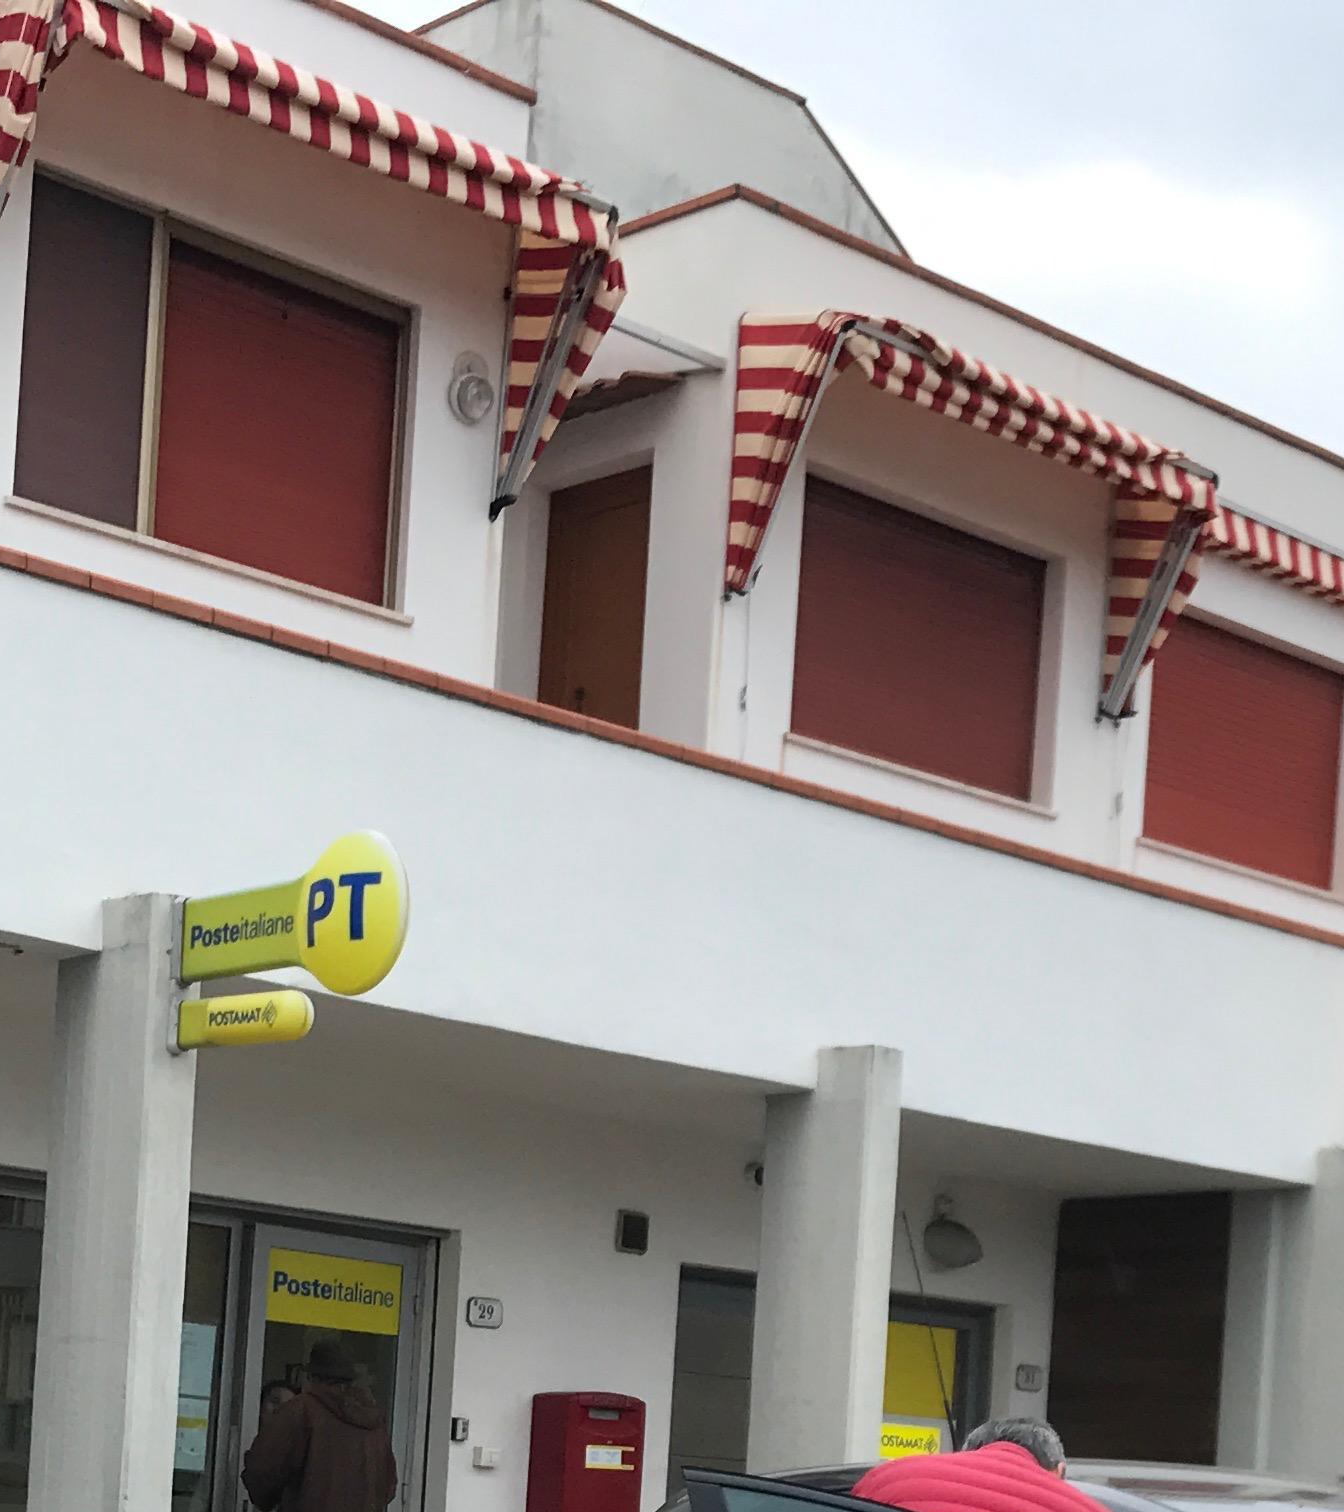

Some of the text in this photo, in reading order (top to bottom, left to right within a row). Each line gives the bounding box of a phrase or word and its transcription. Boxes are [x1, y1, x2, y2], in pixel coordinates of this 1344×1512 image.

[307, 872, 382, 948] PT
[190, 913, 295, 950] Posteitaliane
[209, 1009, 261, 1027] POSTAMAT
[272, 1270, 395, 1308] Posteitaliane
[478, 1303, 494, 1320] 29
[881, 1434, 924, 1451] OSTAMAT
